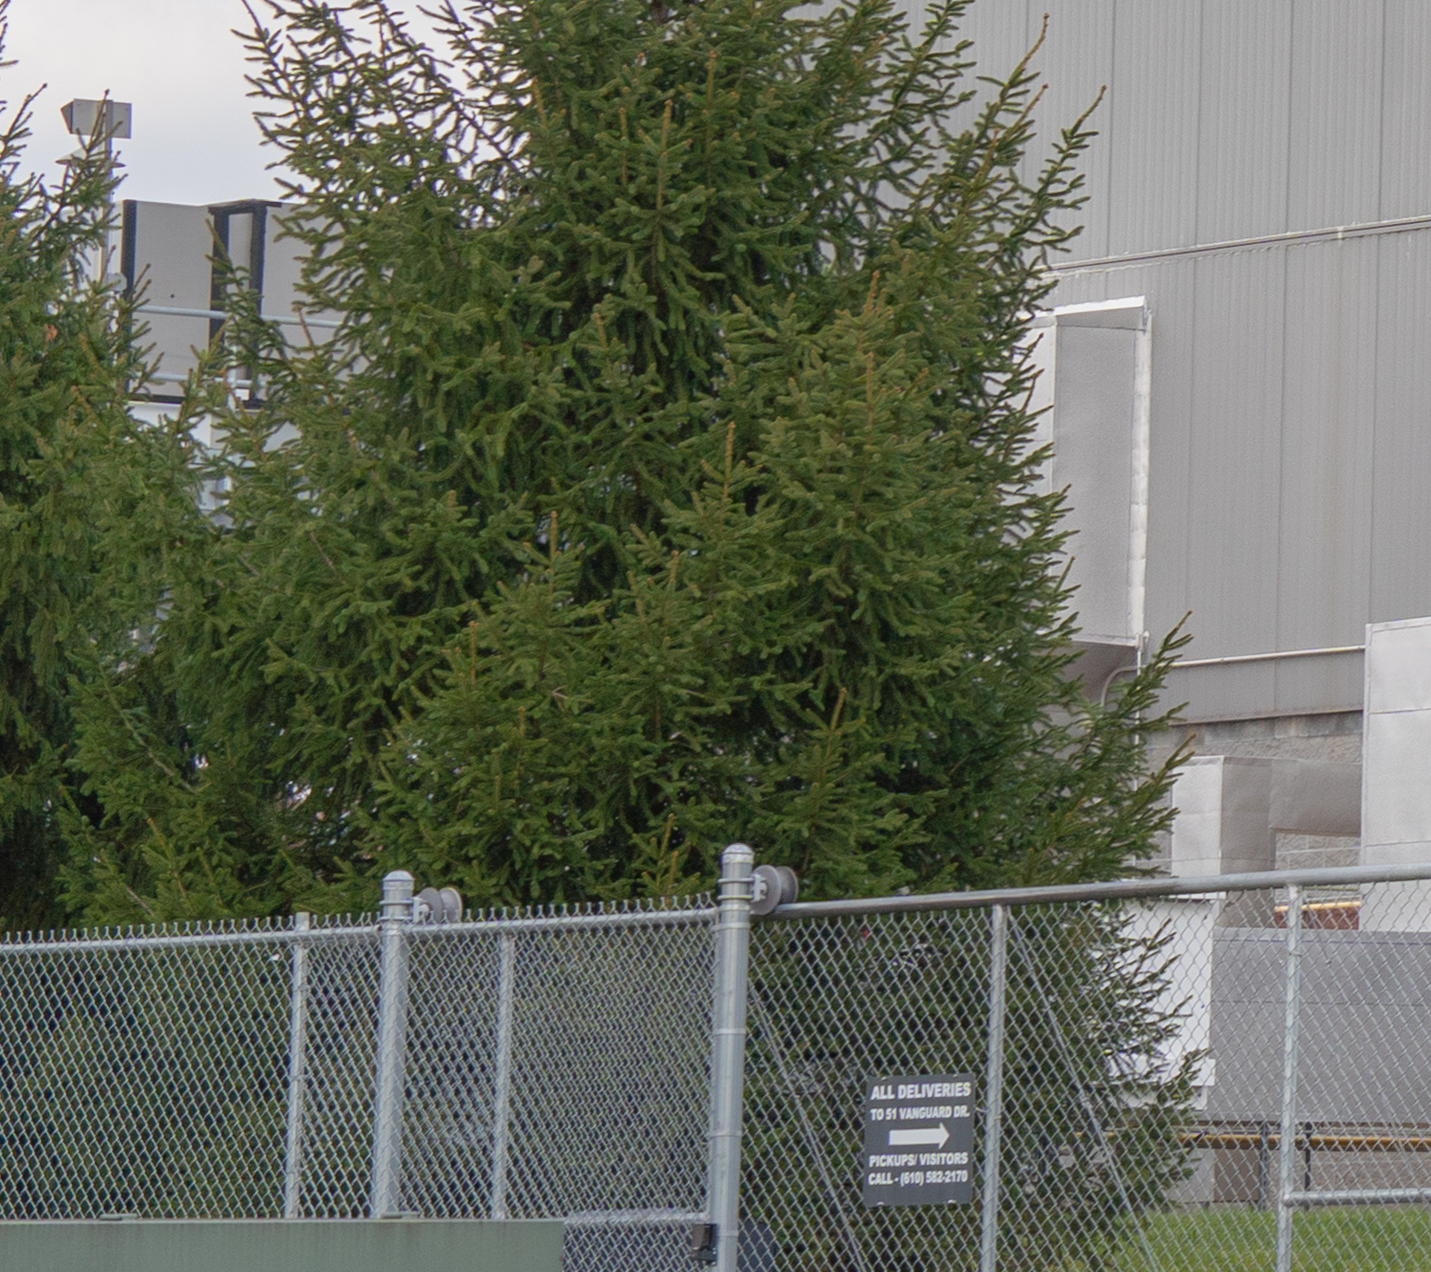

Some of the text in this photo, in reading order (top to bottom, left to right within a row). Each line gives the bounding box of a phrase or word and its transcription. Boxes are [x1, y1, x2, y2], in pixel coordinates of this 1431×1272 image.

[870, 1082, 971, 1100] ALL DELIVERIES
[870, 1105, 970, 1120] TO 51 VANGUARD DR.
[919, 1152, 968, 1166] VISITORS
[868, 1172, 893, 1185] CALL
[900, 1172, 924, 1187] (610)
[926, 1170, 968, 1183] 582-2170
